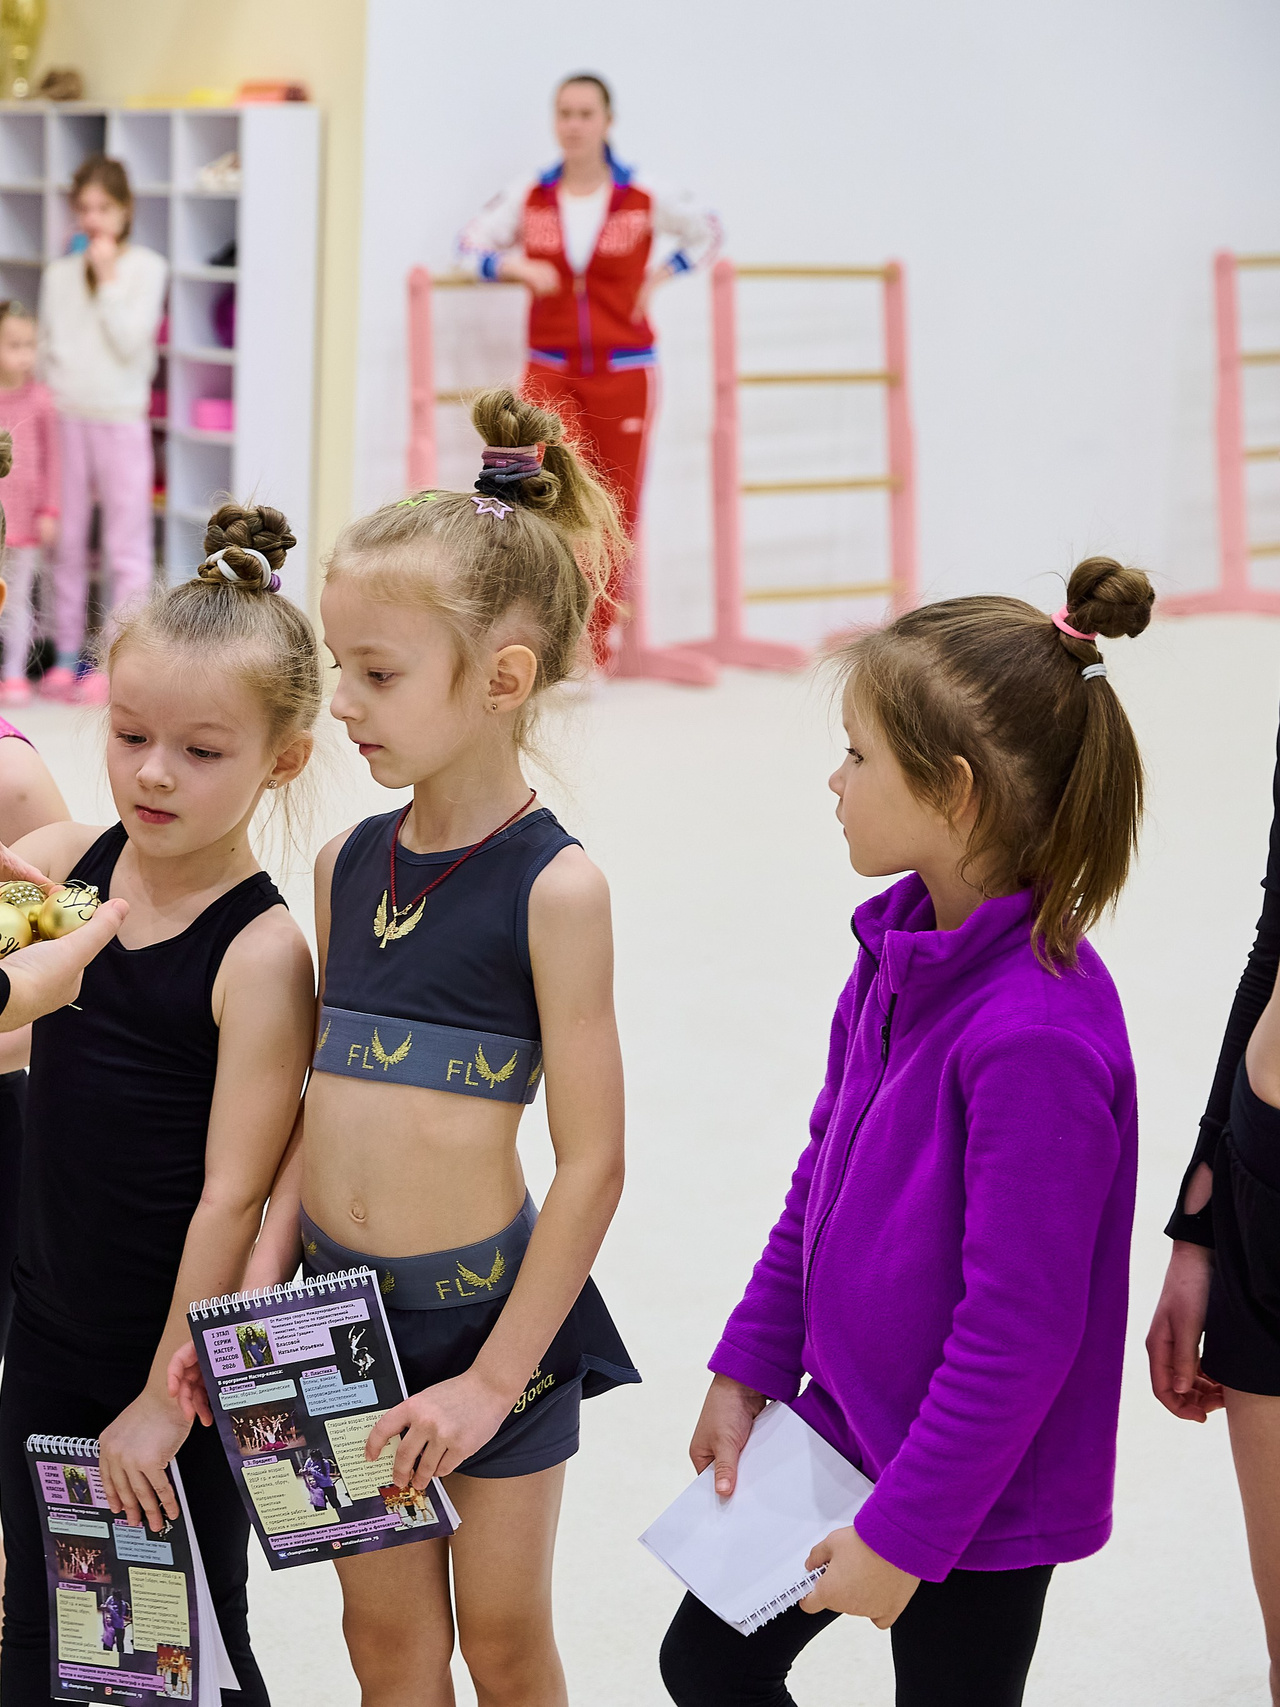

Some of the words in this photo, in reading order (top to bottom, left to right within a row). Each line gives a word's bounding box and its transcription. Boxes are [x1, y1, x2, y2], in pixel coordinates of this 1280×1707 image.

[276, 1339, 300, 1347] Власовой
[299, 1342, 325, 1351] Юрьевны
[213, 1346, 236, 1354] МАСТЕР-
[214, 1354, 239, 1362] КЛАССОВ
[229, 1383, 253, 1391] Артистика
[513, 1373, 556, 1413] gova
